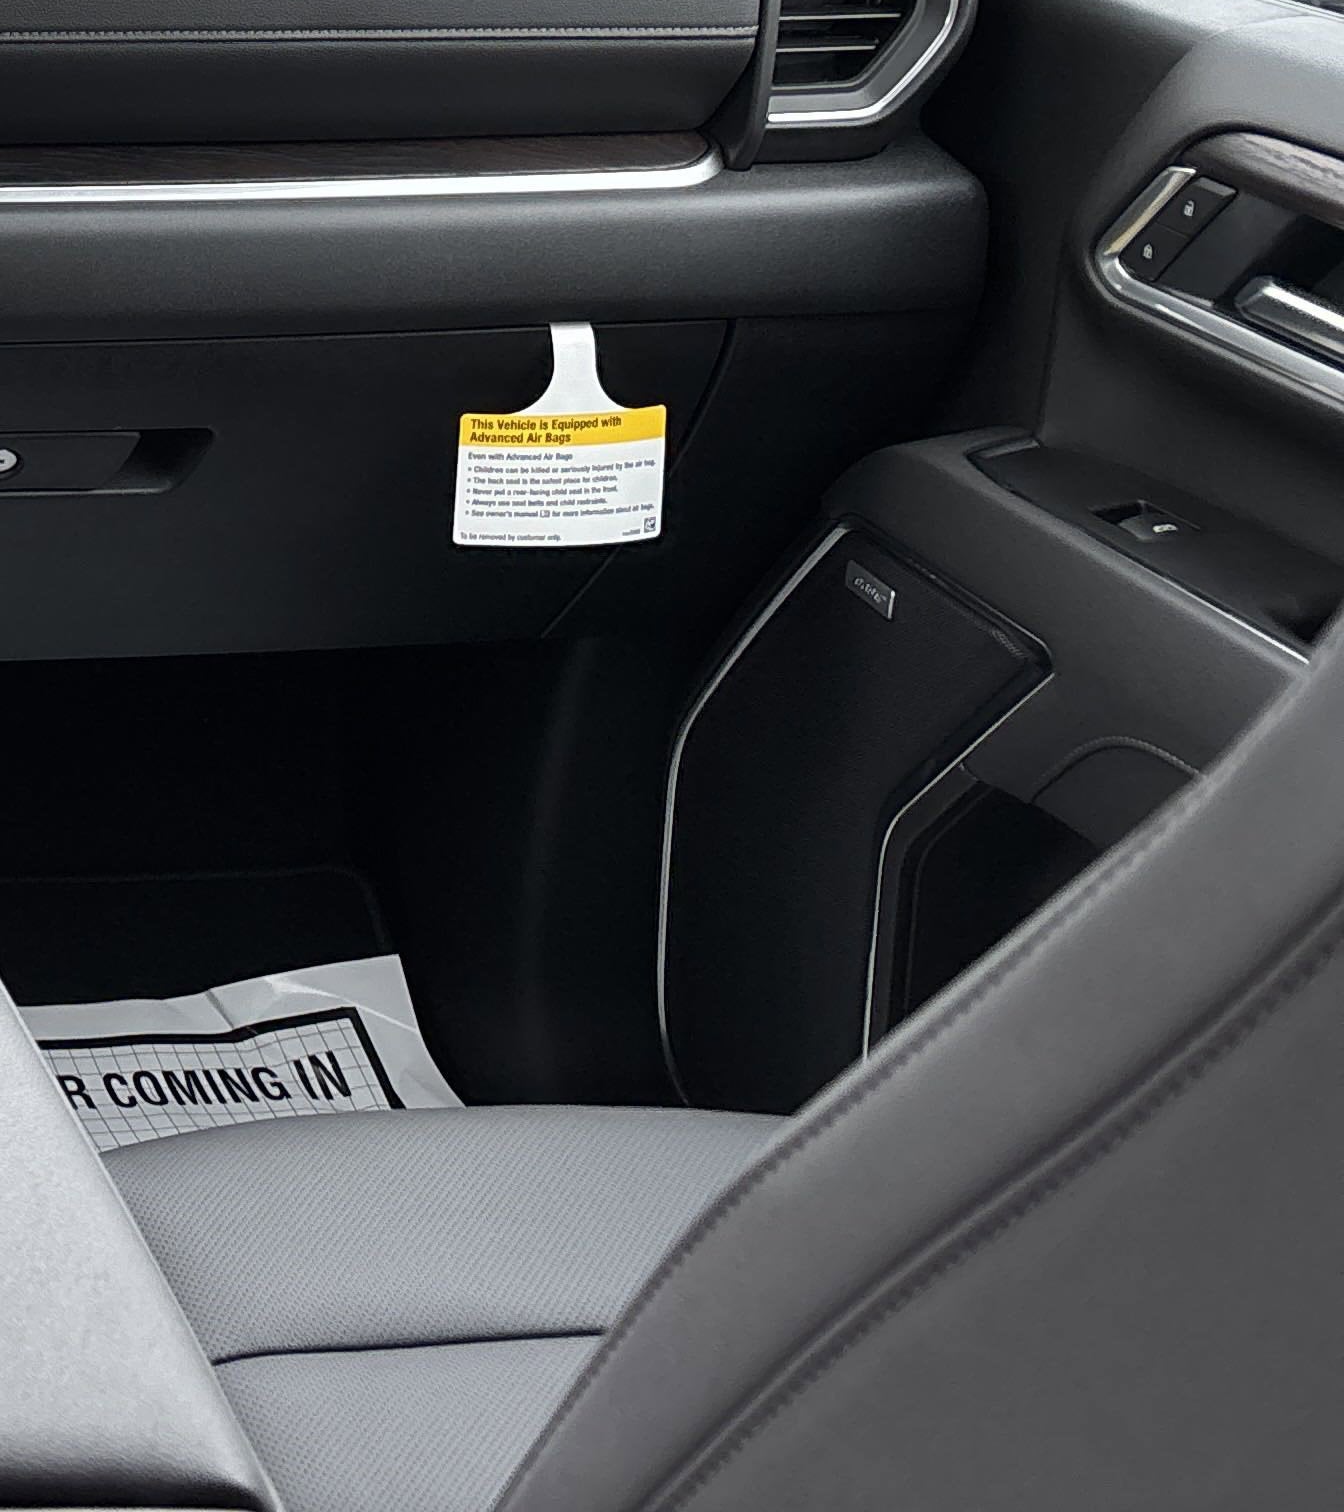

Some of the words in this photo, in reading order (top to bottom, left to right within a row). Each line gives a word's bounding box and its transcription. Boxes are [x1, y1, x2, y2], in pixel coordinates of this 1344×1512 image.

[470, 418, 494, 430] This
[497, 419, 537, 431] Vehicle
[539, 419, 549, 430] is
[551, 417, 599, 432] Equipped
[601, 415, 622, 427] with
[469, 431, 524, 443] Advanced
[526, 432, 543, 443] Air
[545, 432, 572, 445] Bags
[468, 451, 487, 460] Even
[488, 452, 505, 460] with
[506, 452, 542, 461] Advanced
[543, 453, 554, 461] Air
[555, 452, 573, 462] Bags
[460, 531, 468, 540] To
[468, 532, 478, 540] be
[478, 533, 507, 541] removed
[507, 533, 516, 542] by
[516, 533, 546, 541] customer
[547, 534, 562, 542] only.
[103, 1065, 293, 1110] COMING
[294, 1050, 353, 1101] IN
